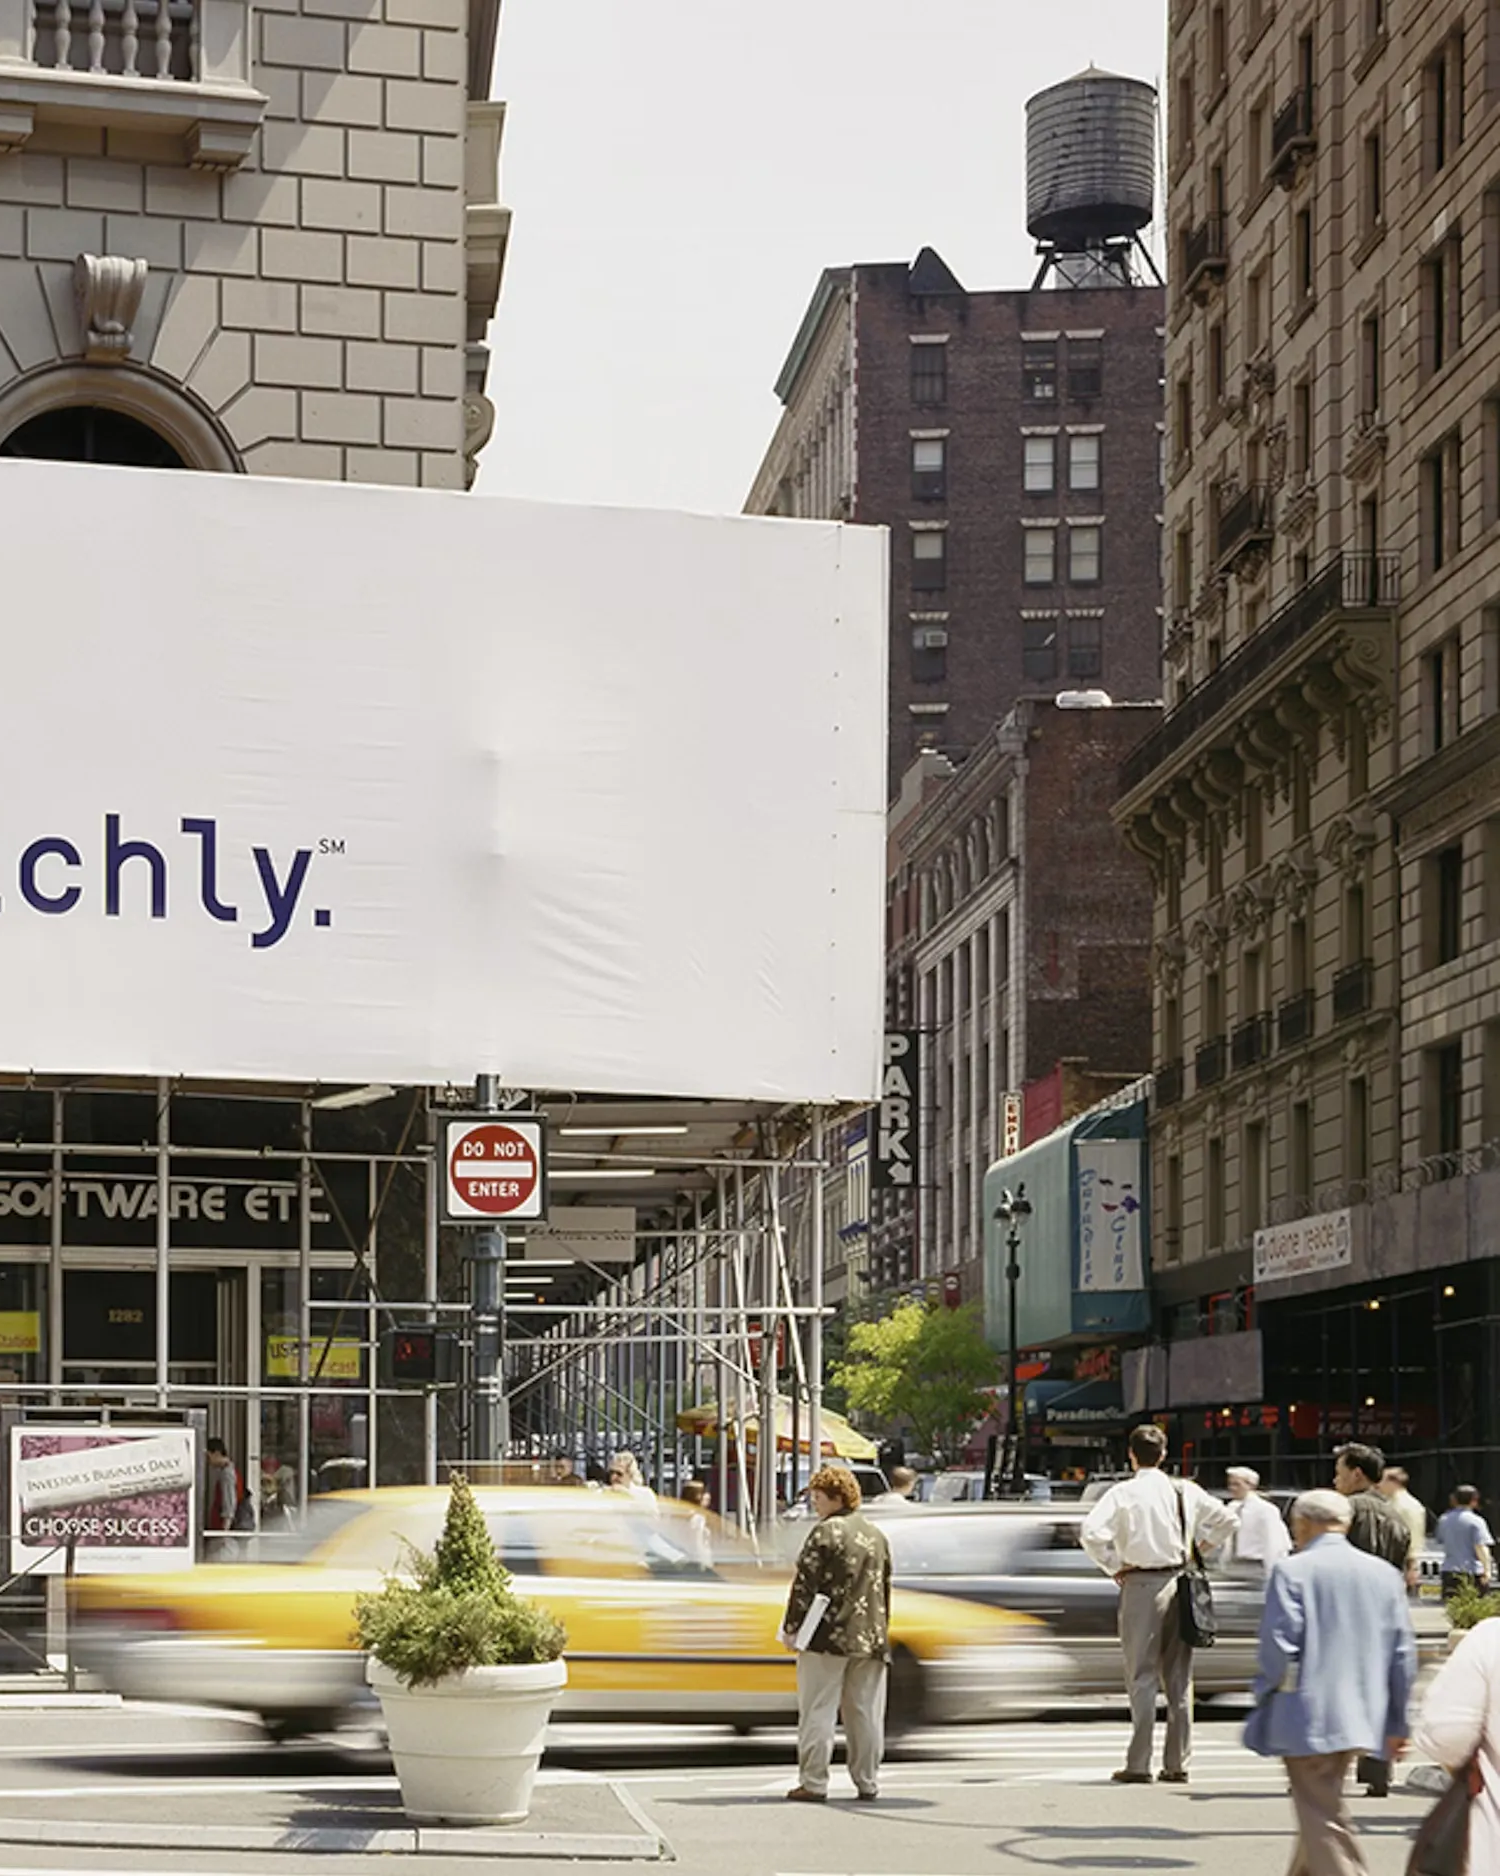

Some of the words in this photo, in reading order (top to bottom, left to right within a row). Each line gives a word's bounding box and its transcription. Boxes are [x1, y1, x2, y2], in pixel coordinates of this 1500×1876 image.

[319, 838, 345, 854] SM
[878, 1033, 912, 1161] PARK
[462, 1140, 485, 1157] DO
[493, 1141, 525, 1157] NOT
[468, 1180, 520, 1197] ENTER
[93, 1463, 146, 1483] BUSINESS
[149, 1457, 182, 1474] DAILY
[25, 1517, 100, 1537] CHOOSE
